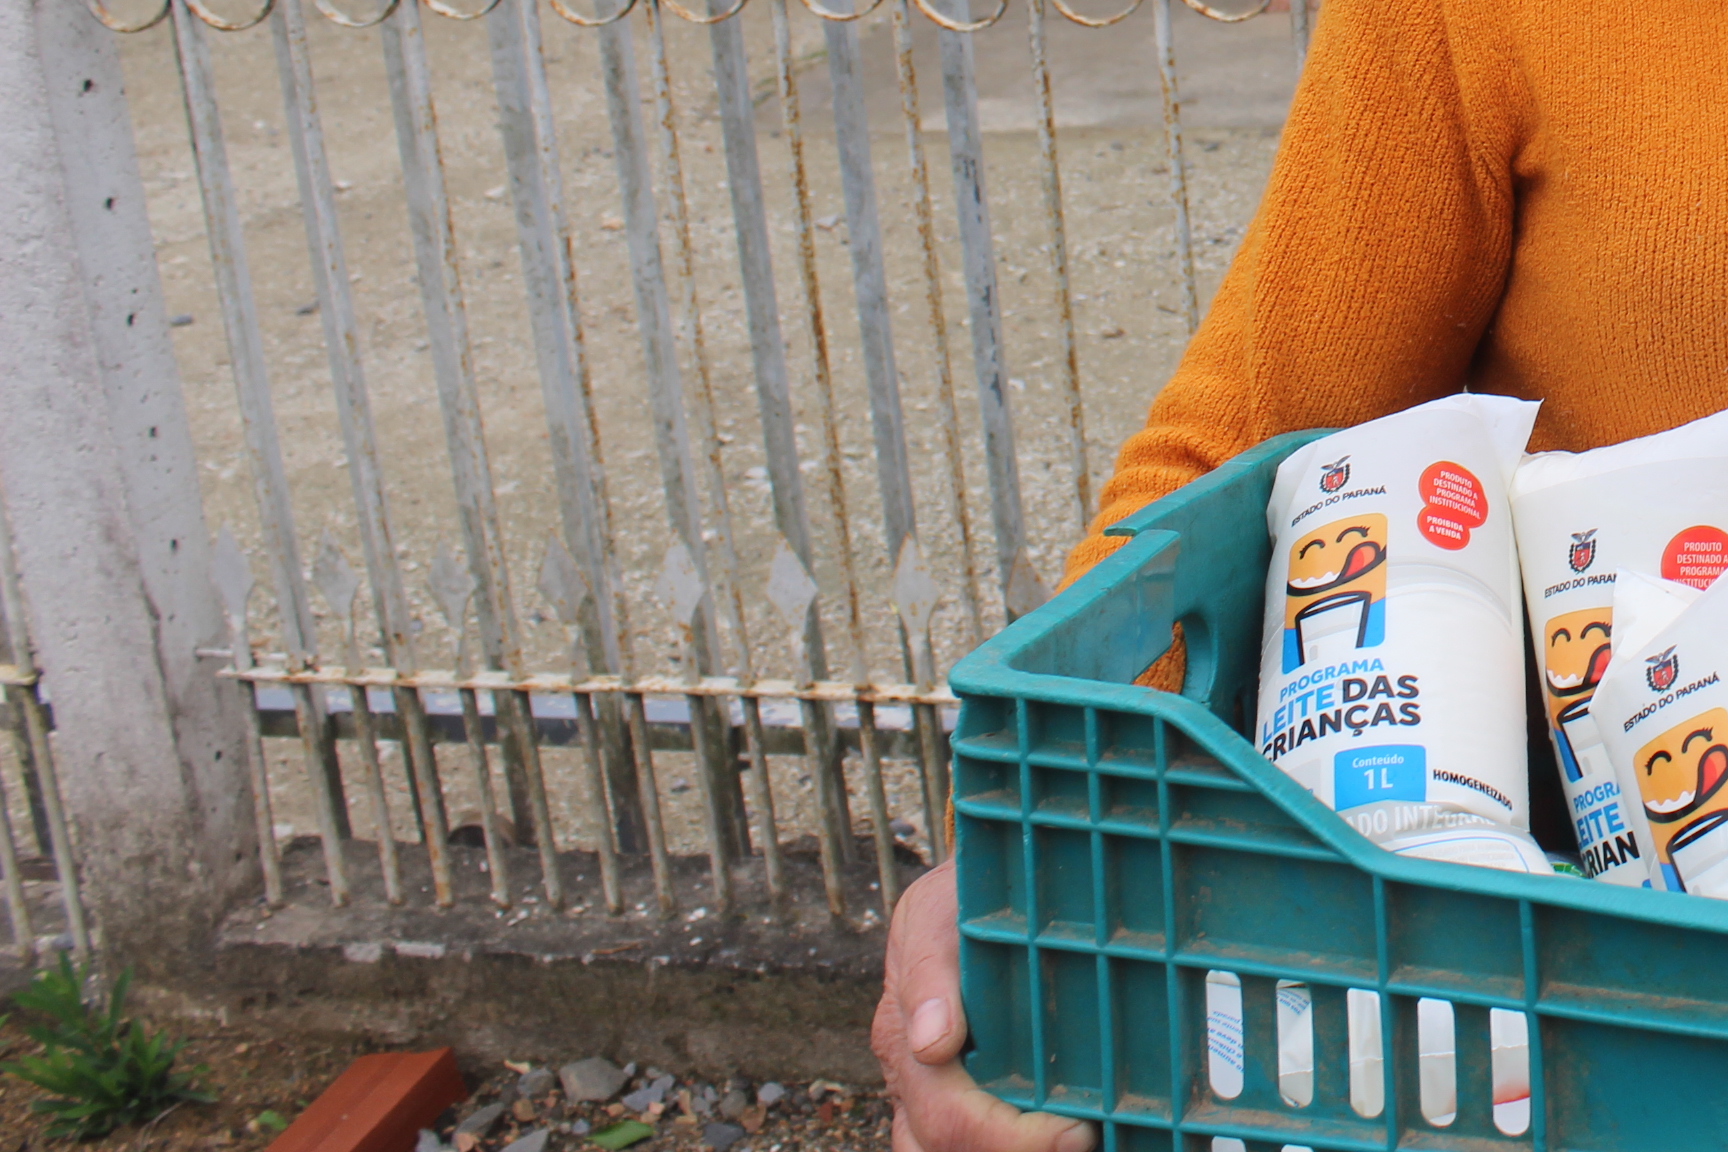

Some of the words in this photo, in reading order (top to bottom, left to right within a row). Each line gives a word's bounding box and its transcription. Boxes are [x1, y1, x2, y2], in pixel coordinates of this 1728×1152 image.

[1434, 478, 1472, 497] DESTINADO
[1441, 471, 1472, 488] PRODUTO
[1291, 502, 1323, 527] ESTADO
[1325, 495, 1340, 507] DO
[1342, 485, 1387, 501] PARANÁ
[1430, 496, 1481, 519] INSTITUCIONAL
[1437, 488, 1475, 507] PROGRAMA
[1427, 516, 1464, 532] PROIBIDA
[1435, 526, 1461, 540] VENDA
[1684, 542, 1722, 551] PRODUTO
[1677, 555, 1721, 564] DESTINADO
[1723, 555, 1728, 563] A
[1544, 582, 1570, 599] ESTADO
[1572, 579, 1585, 588] DO
[1280, 658, 1384, 702] PROGRAMA
[1262, 684, 1335, 746] LEITE
[1342, 675, 1419, 704] DAS
[1624, 703, 1656, 733] ESTADO
[1659, 694, 1674, 709] DO
[1676, 672, 1720, 700] PARANÁ
[1262, 702, 1421, 762] CRIANÇAS
[1352, 754, 1404, 768] Conteúdo
[1434, 769, 1512, 810] HOMOGENEIZADO
[1576, 802, 1625, 850] EITE
